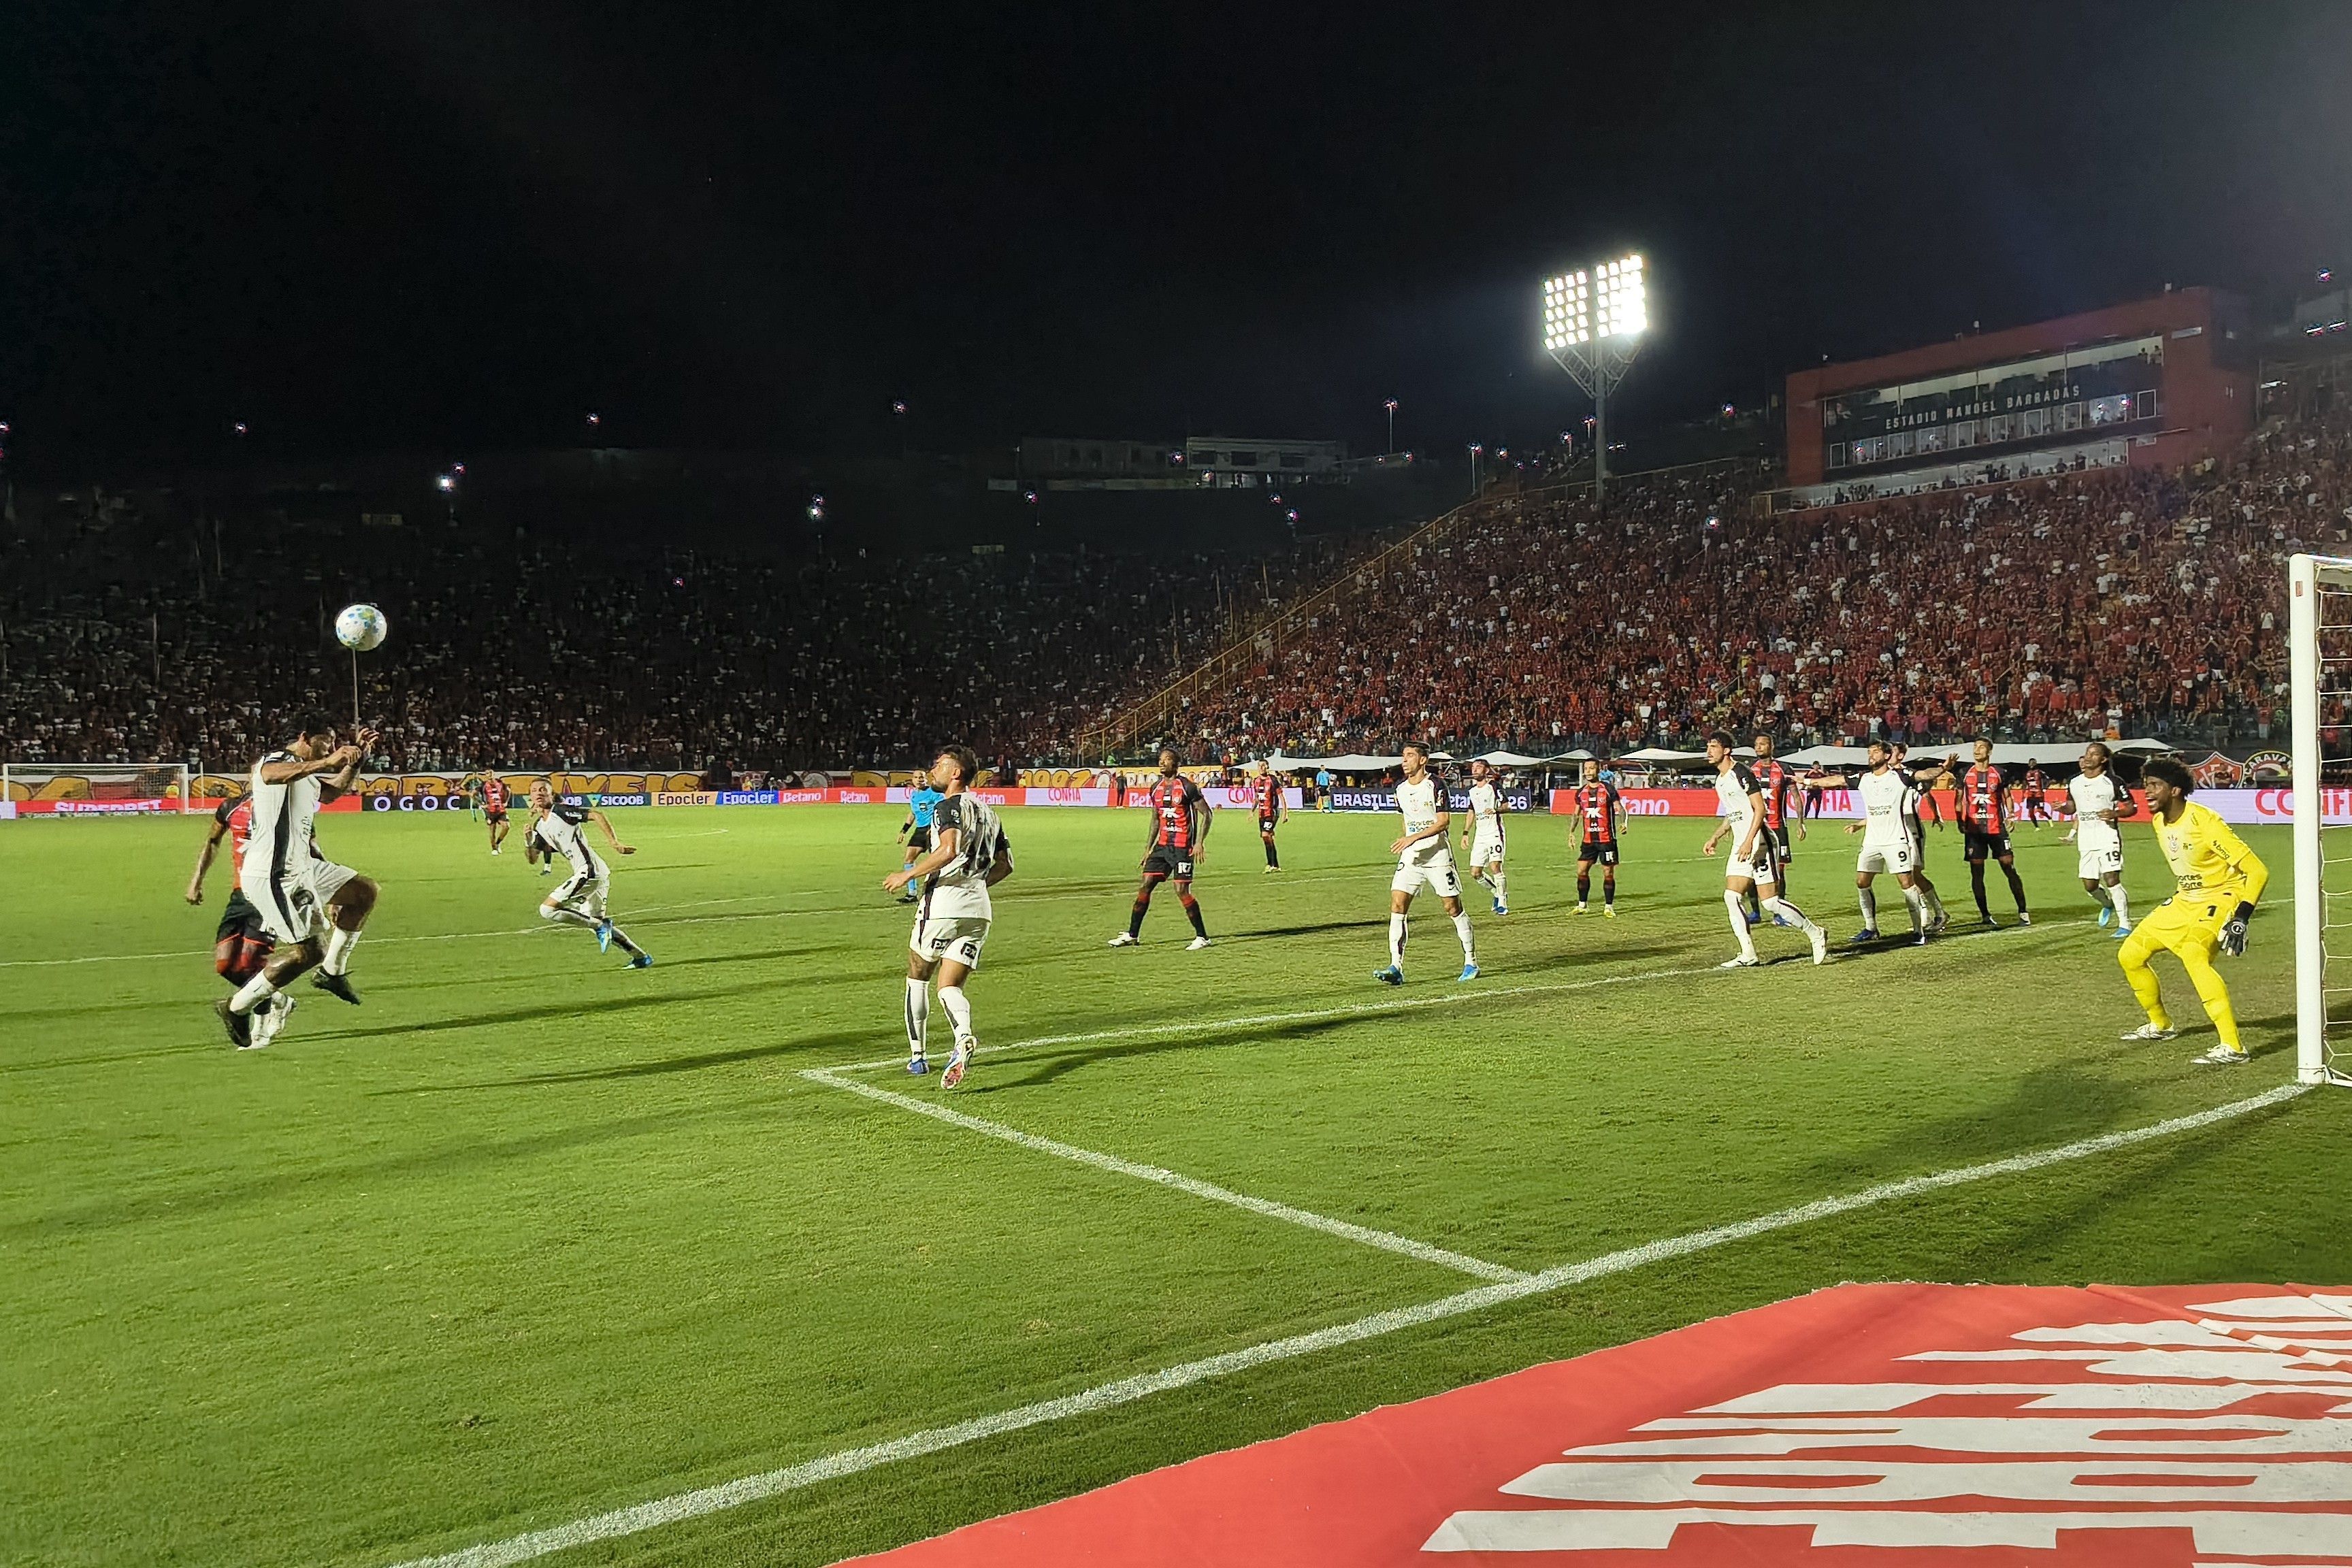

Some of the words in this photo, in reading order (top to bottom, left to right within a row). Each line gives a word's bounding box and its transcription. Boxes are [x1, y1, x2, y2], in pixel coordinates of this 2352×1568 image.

[1946, 400, 1996, 419] MANOEL
[2007, 385, 2080, 408] BARRADAS
[2244, 753, 2292, 774] CARAVAN
[601, 795, 644, 806] SICOOB
[658, 794, 710, 805] Epocler
[723, 791, 774, 804] Epocler
[783, 791, 821, 803] Betano
[840, 791, 870, 804] Betano
[1048, 788, 1081, 802] CONFIA
[1129, 792, 1153, 807] Bet
[1229, 787, 1254, 804] CON
[1333, 793, 1398, 807] BRASILE
[1450, 794, 1470, 808] eta
[1508, 796, 1528, 810] 26
[2255, 789, 2352, 815] COFI
[1620, 796, 1669, 815] tano
[1490, 845, 1502, 854] 20
[1898, 851, 1906, 862] 9
[2106, 850, 2120, 862] 19
[2216, 844, 2230, 860] bmg
[1446, 870, 1455, 885] 3
[2207, 905, 2217, 917] 1
